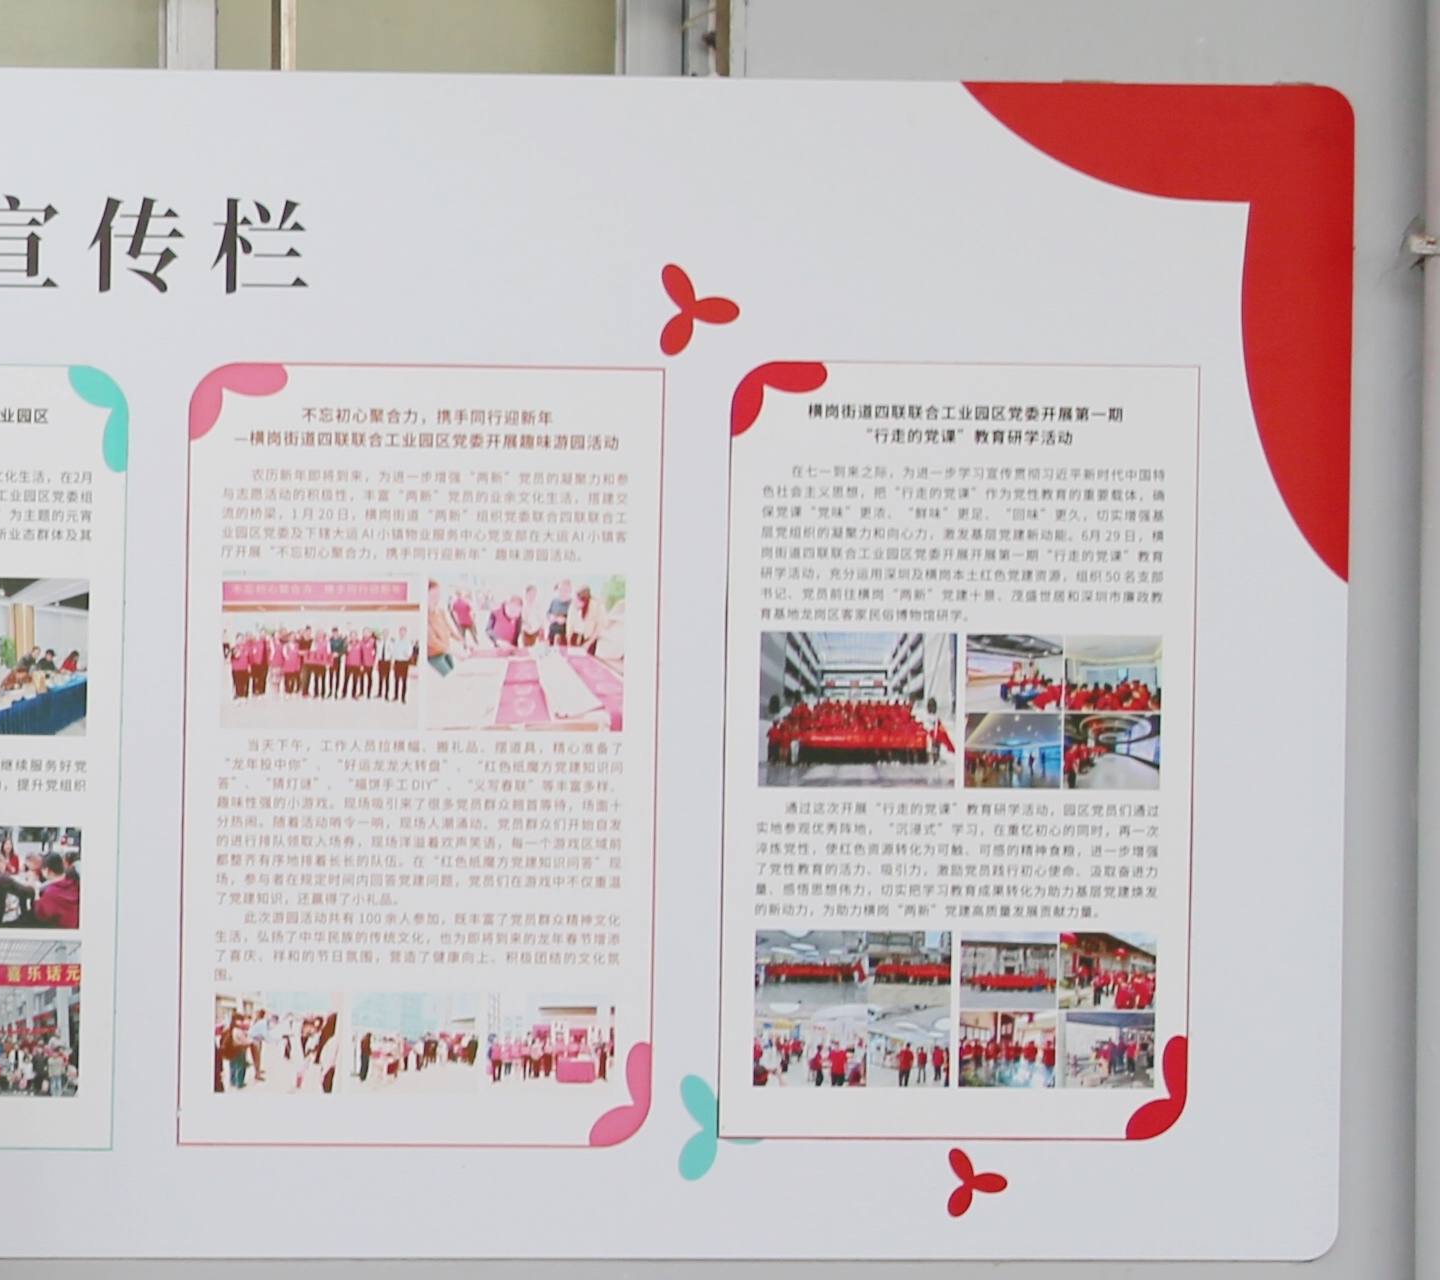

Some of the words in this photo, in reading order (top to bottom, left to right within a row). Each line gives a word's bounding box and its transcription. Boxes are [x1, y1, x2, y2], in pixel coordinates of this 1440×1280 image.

[302, 407, 552, 426] 不忘初心聚合力，携手同行迎新年
[808, 404, 1123, 422] 横岗街道四联联合工业园区党委开展第一期
[867, 428, 1072, 445] “行走的党课”教育研学活动
